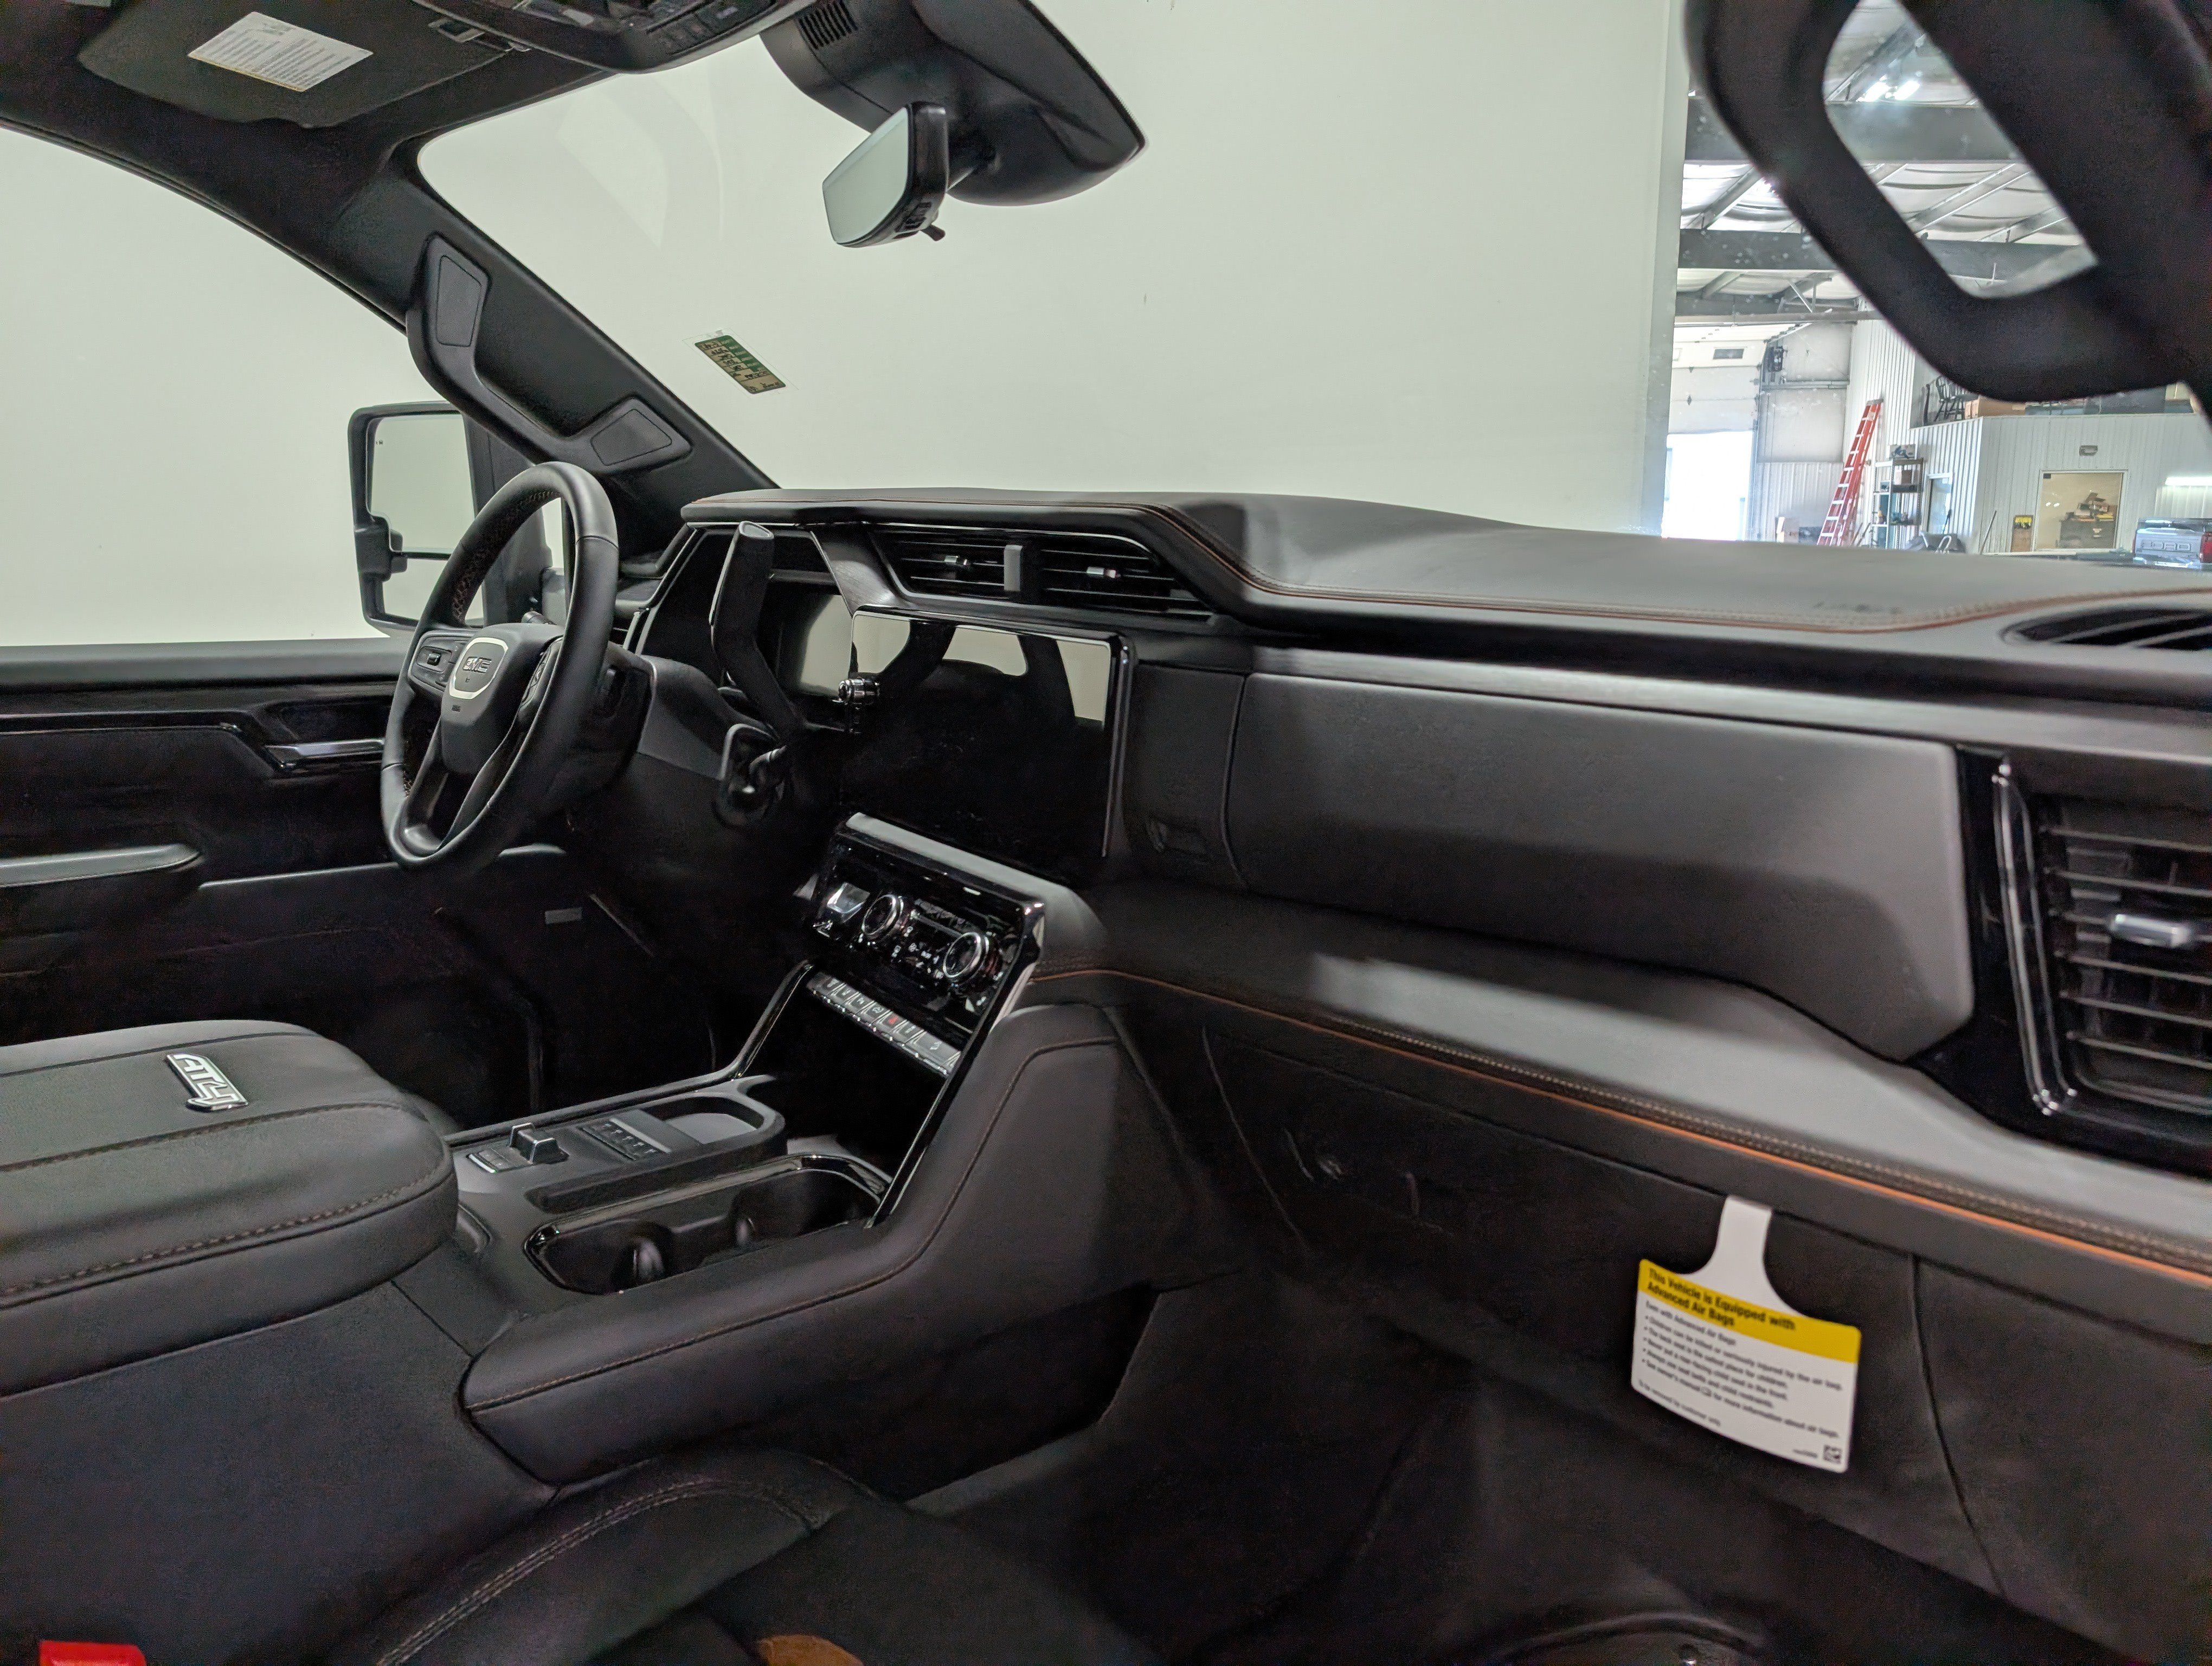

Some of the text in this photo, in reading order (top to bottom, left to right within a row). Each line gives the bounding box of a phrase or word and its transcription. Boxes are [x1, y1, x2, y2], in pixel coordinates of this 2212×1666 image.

[462, 657, 492, 674] GMC
[173, 1053, 241, 1105] AT4
[1648, 1281, 1735, 1327] Advanced Air Bags
[1715, 1297, 1766, 1323] Equipped
